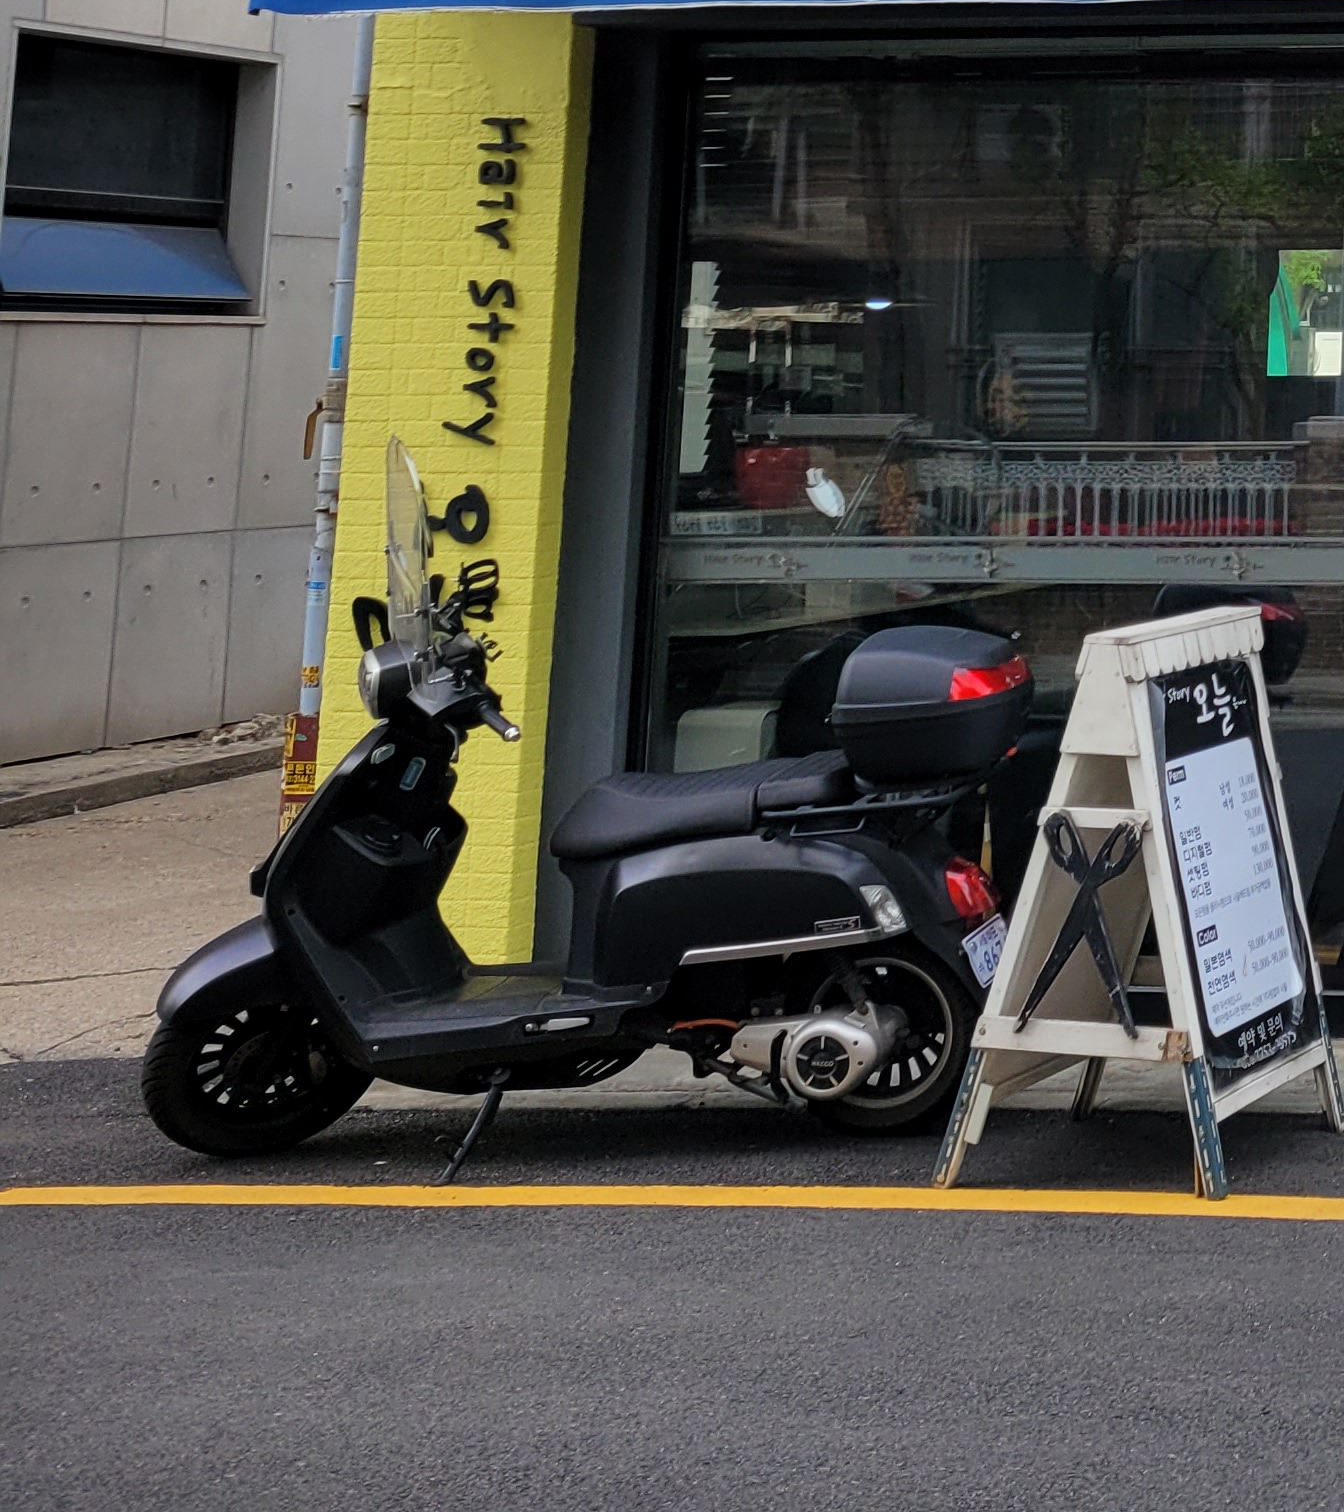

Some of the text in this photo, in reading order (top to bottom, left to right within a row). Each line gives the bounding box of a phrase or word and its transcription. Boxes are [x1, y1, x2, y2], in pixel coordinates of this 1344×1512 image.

[441, 116, 526, 445] Hair Story
[1167, 685, 1191, 704] Story
[1198, 928, 1218, 946] Color
